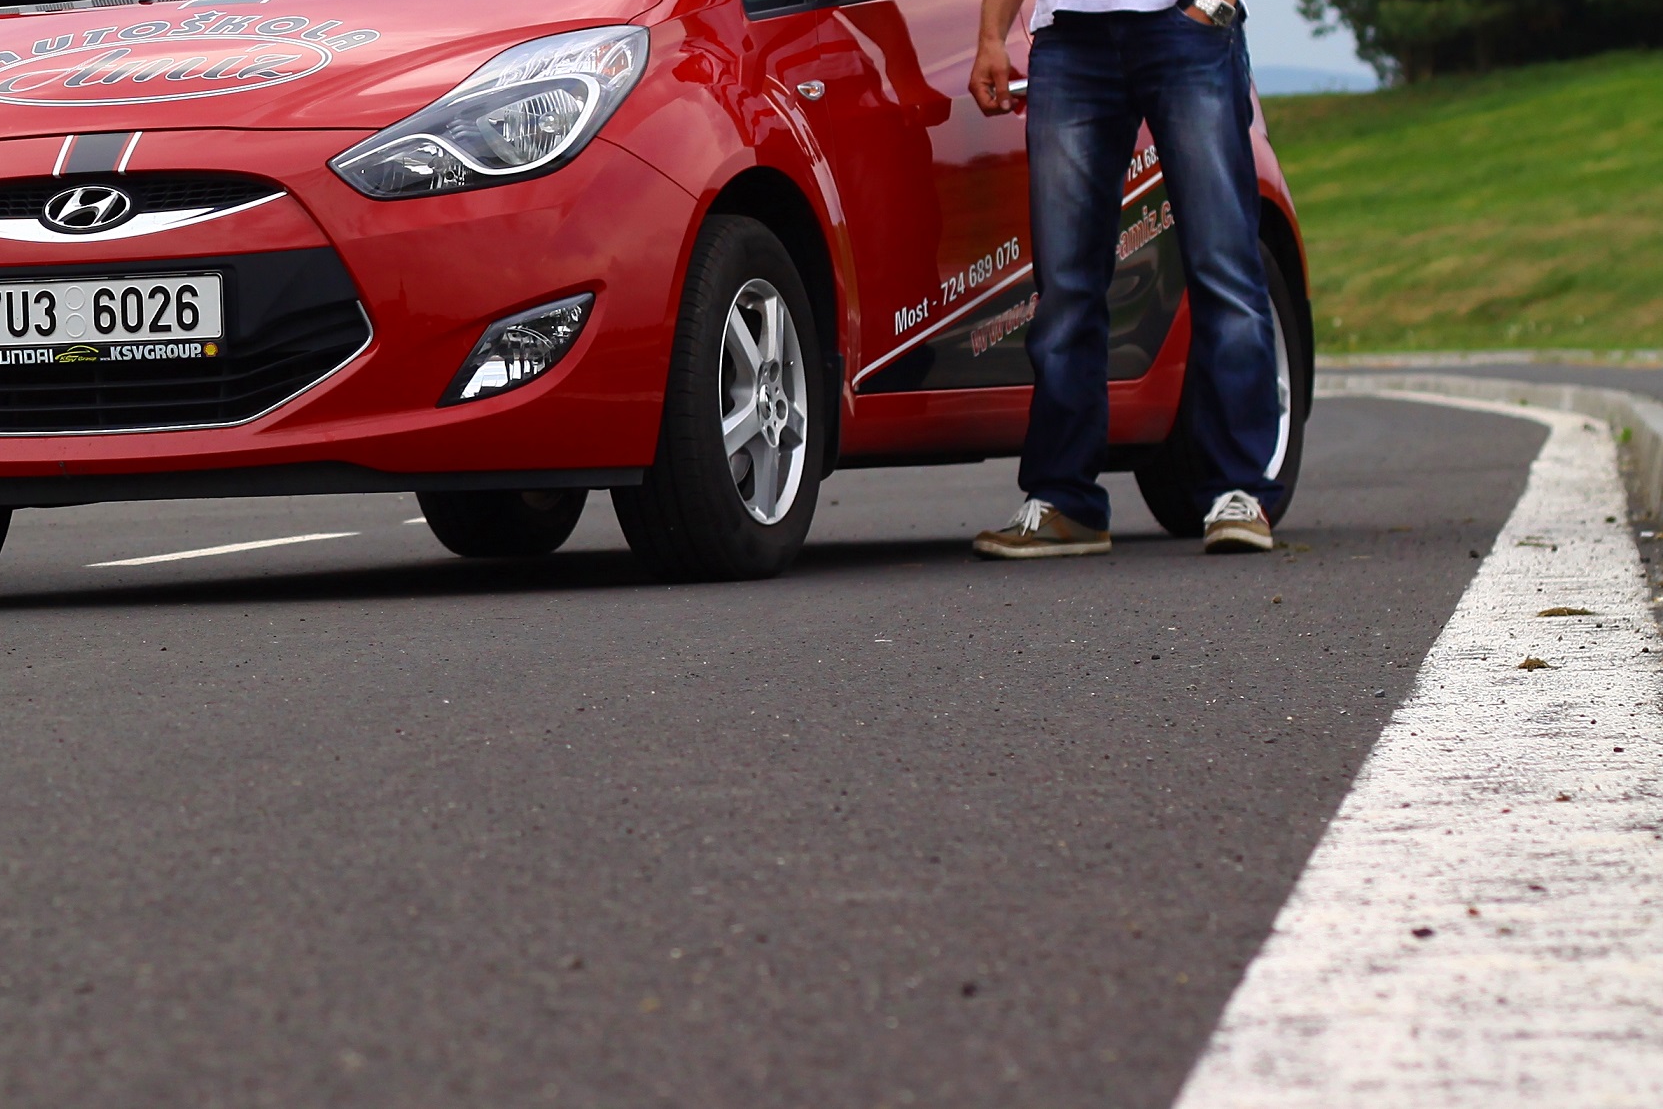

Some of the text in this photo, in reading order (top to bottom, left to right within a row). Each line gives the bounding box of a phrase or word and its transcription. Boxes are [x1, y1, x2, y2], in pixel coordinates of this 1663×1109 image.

[1143, 144, 1159, 168] 68
[92, 283, 201, 335] 6026
[895, 297, 929, 336] Most
[940, 271, 966, 307] 724
[968, 254, 993, 288] 689
[995, 237, 1020, 270] 076
